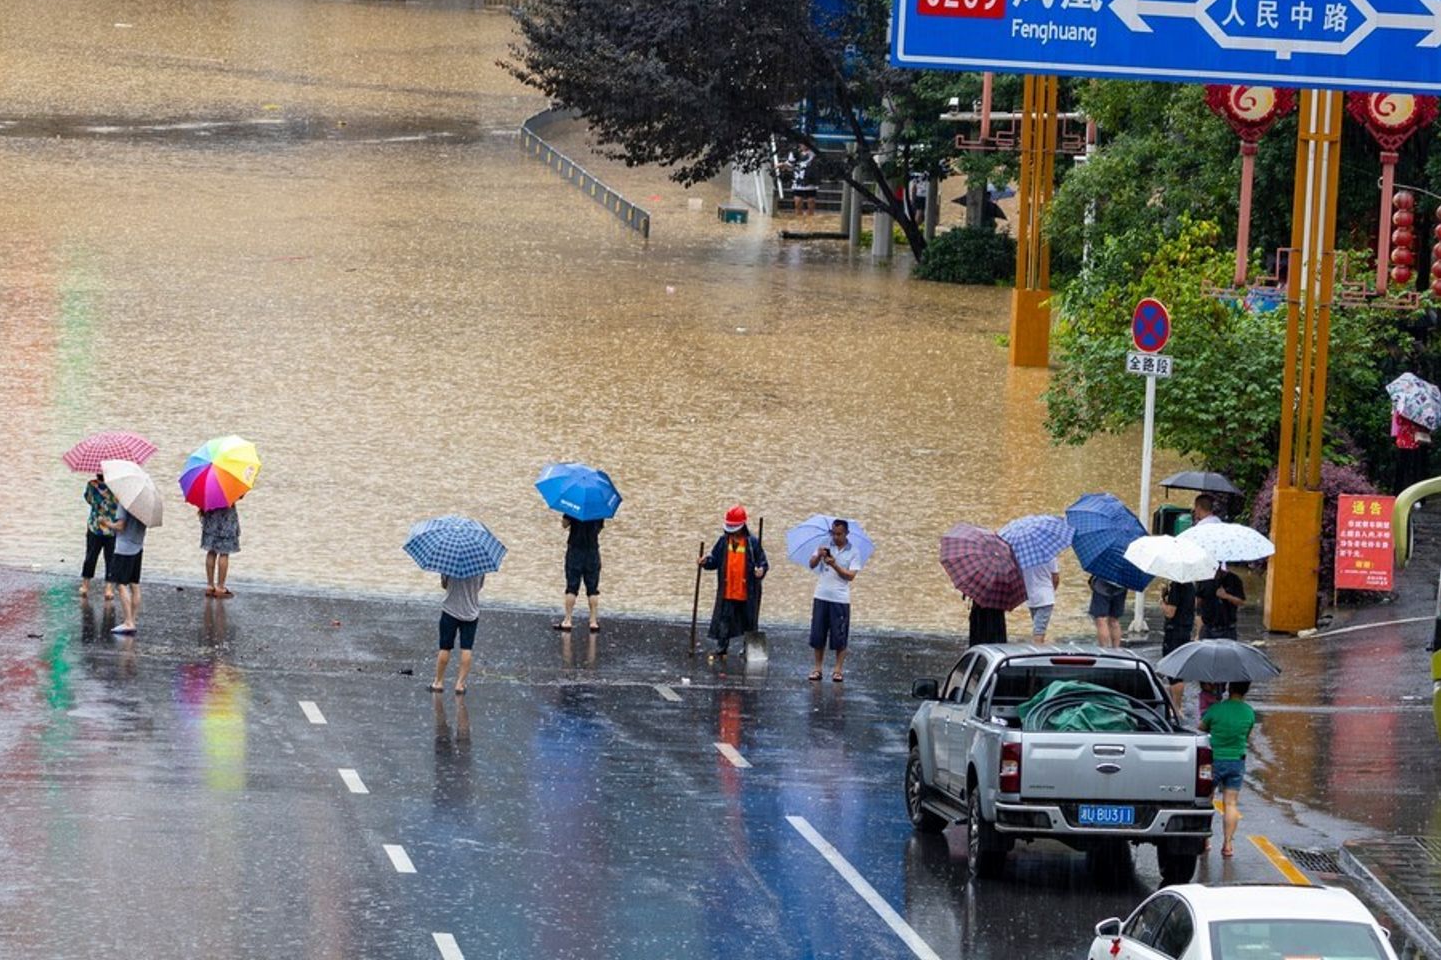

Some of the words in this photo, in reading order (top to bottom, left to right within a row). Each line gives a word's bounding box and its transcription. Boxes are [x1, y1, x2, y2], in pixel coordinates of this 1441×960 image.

[1012, 18, 1098, 47] Fenghuang
[1130, 355, 1168, 374] 全路段
